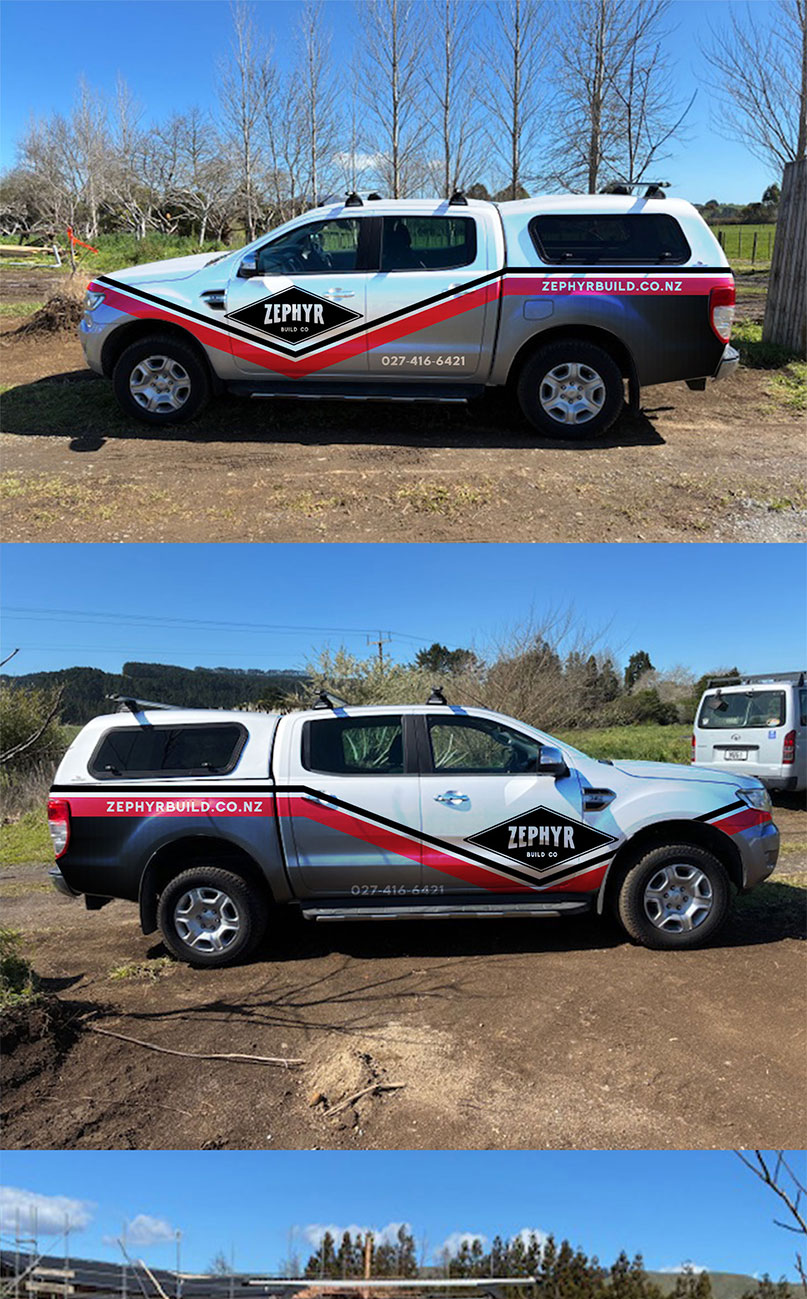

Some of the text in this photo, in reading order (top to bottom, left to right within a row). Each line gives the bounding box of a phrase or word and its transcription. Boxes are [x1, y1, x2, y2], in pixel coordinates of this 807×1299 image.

[541, 281, 683, 292] ZEPHYRBUILD.CO.NZ
[263, 303, 325, 325] ZEPHYR
[381, 355, 466, 367] 027-416-6421
[106, 801, 263, 813] ZEPHYRBUILD.CO.NZ
[507, 826, 575, 849] ZEPHYR
[351, 884, 445, 896] 027-416-6421
